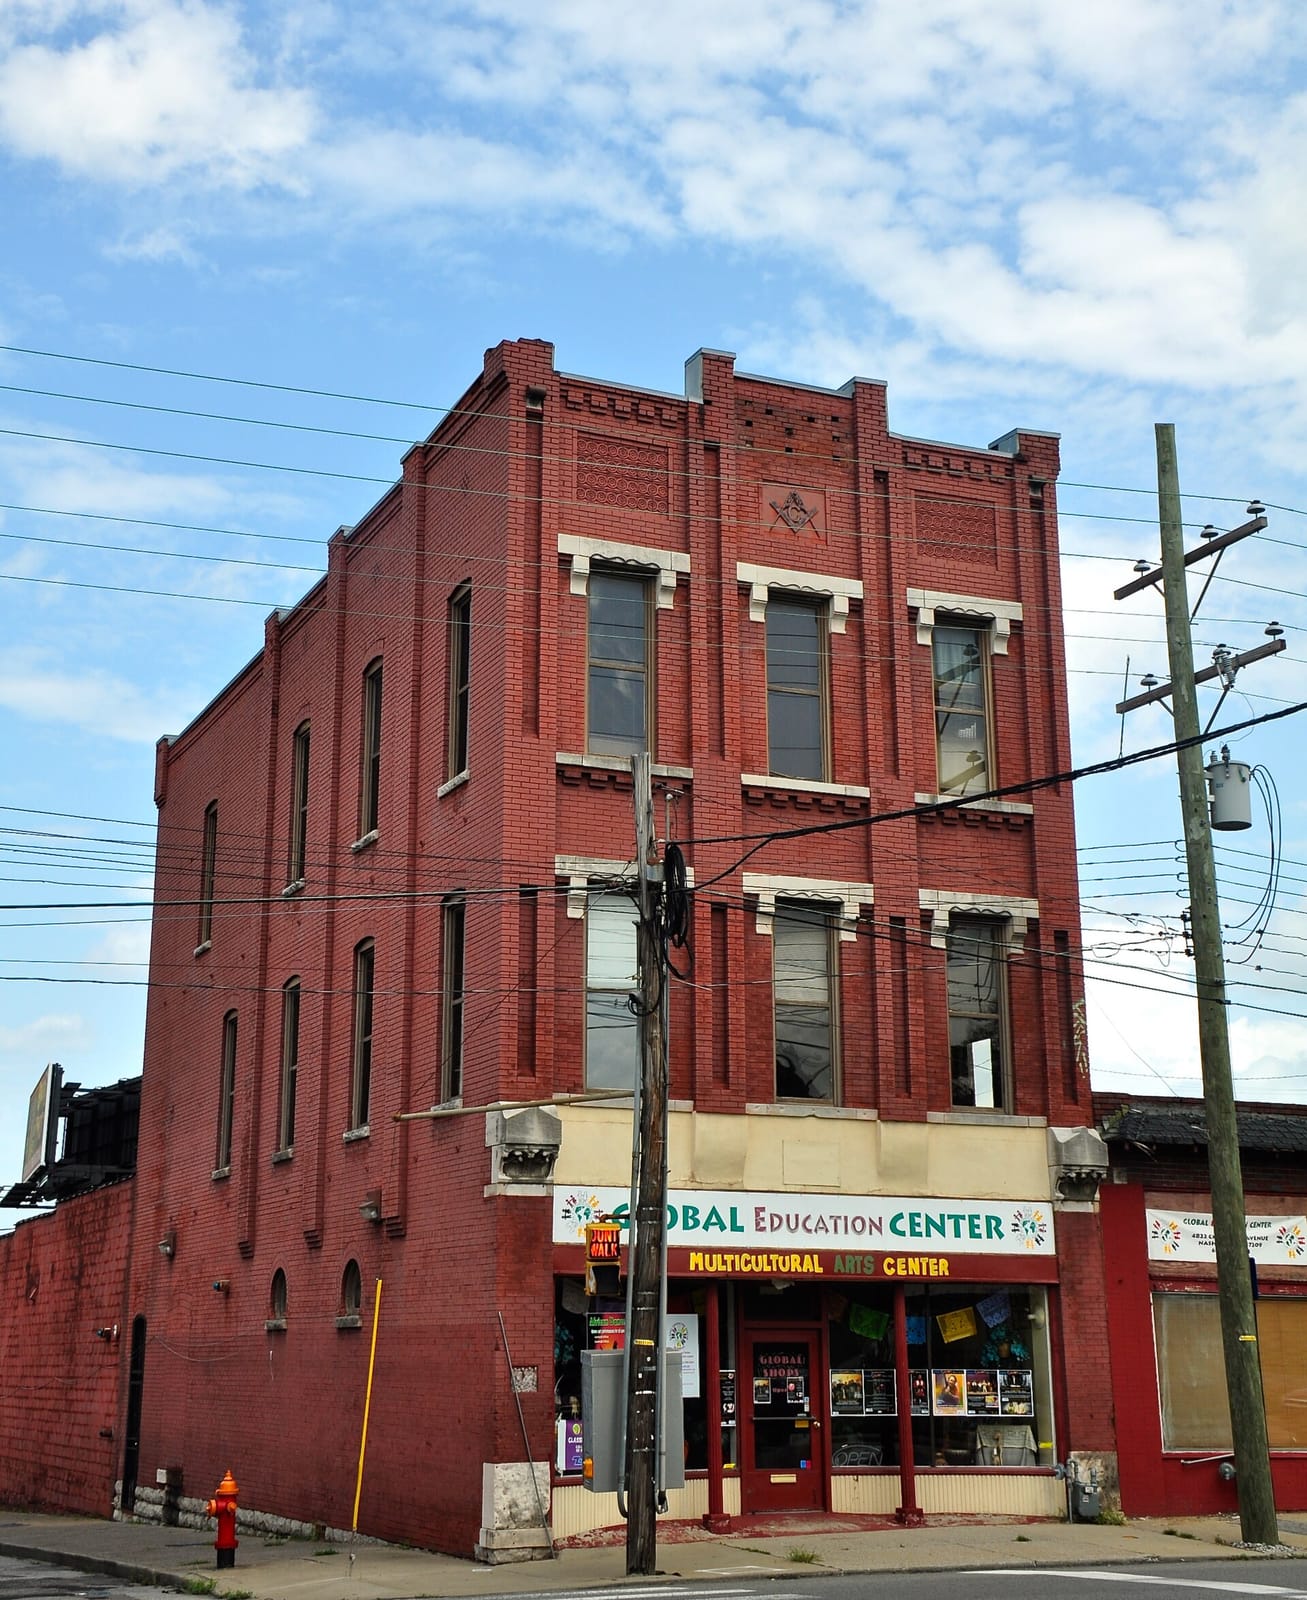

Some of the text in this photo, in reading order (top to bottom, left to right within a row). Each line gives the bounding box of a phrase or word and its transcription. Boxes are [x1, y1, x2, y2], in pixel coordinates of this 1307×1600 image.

[612, 1202, 1005, 1240] GBAL EDUCATION CENTER
[591, 1243, 617, 1257] WALK
[689, 1251, 950, 1277] MULTICULTURAL ARTS CENTER
[760, 1355, 802, 1365] GLOBAL
[763, 1368, 800, 1378] SHOPS
